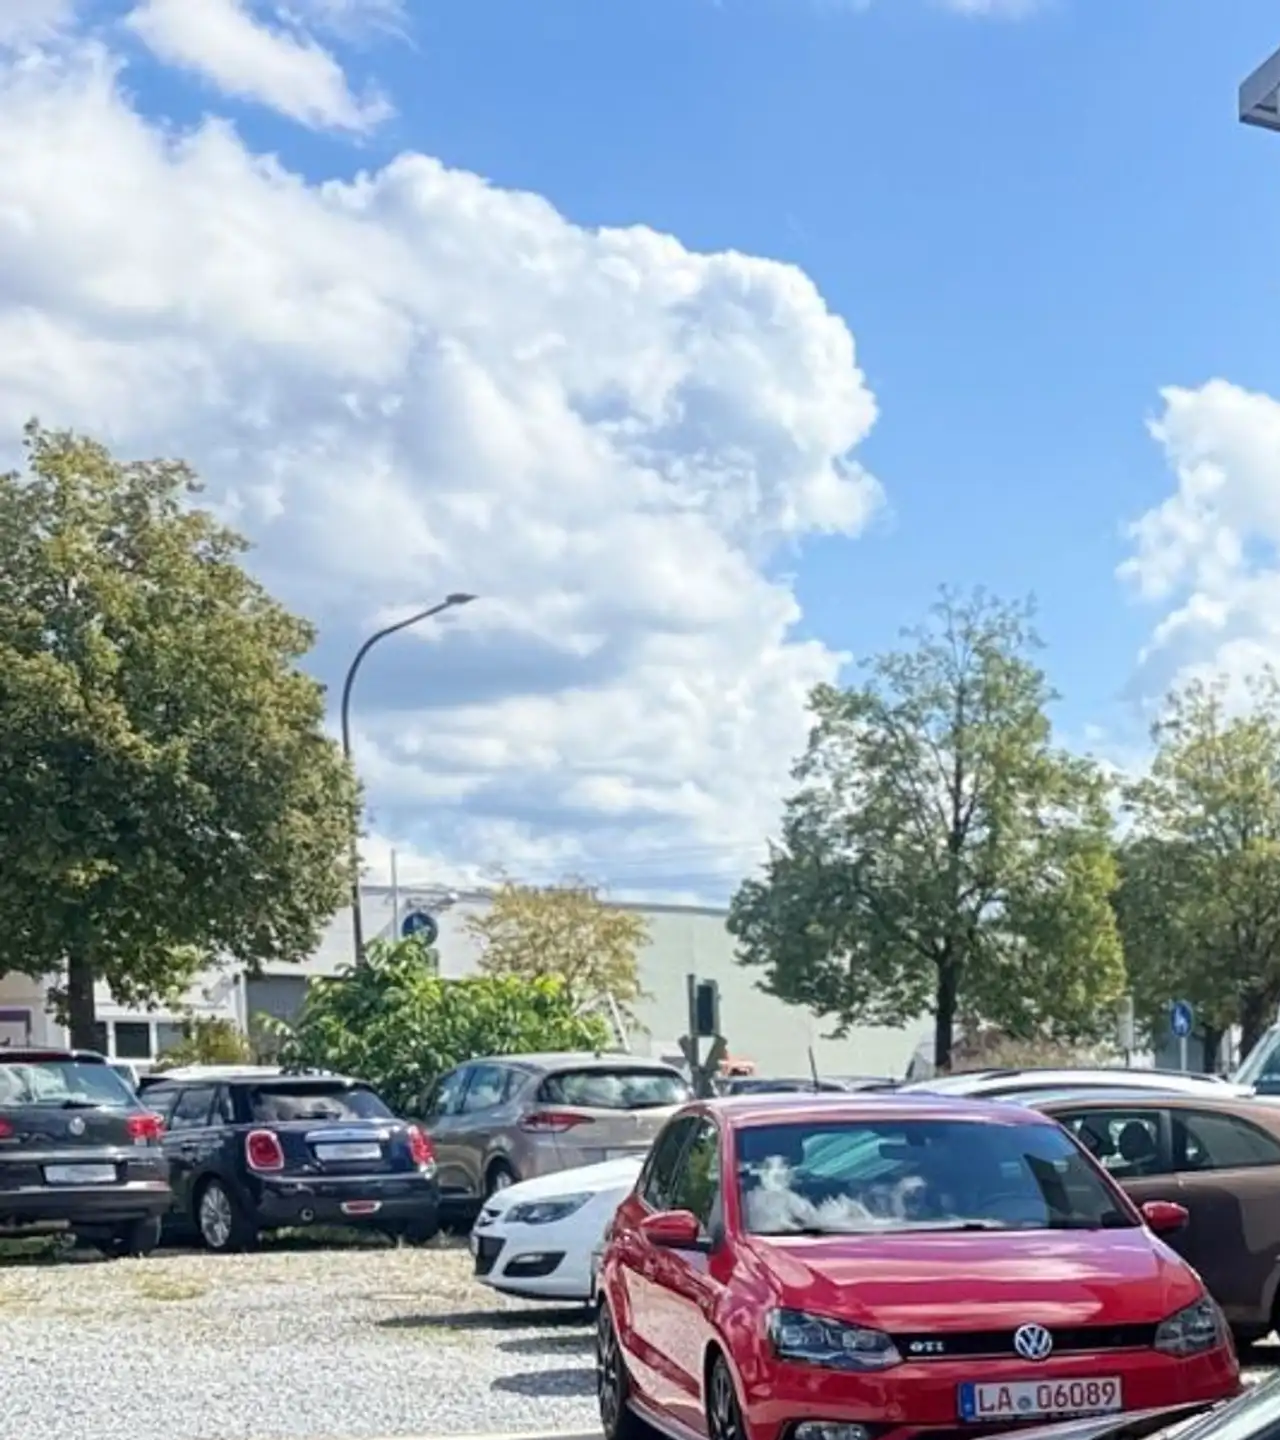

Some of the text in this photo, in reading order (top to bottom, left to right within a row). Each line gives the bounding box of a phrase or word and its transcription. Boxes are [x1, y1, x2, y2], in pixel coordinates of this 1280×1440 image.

[909, 1340, 945, 1353] GTI
[977, 1381, 1117, 1413] LA 06089
